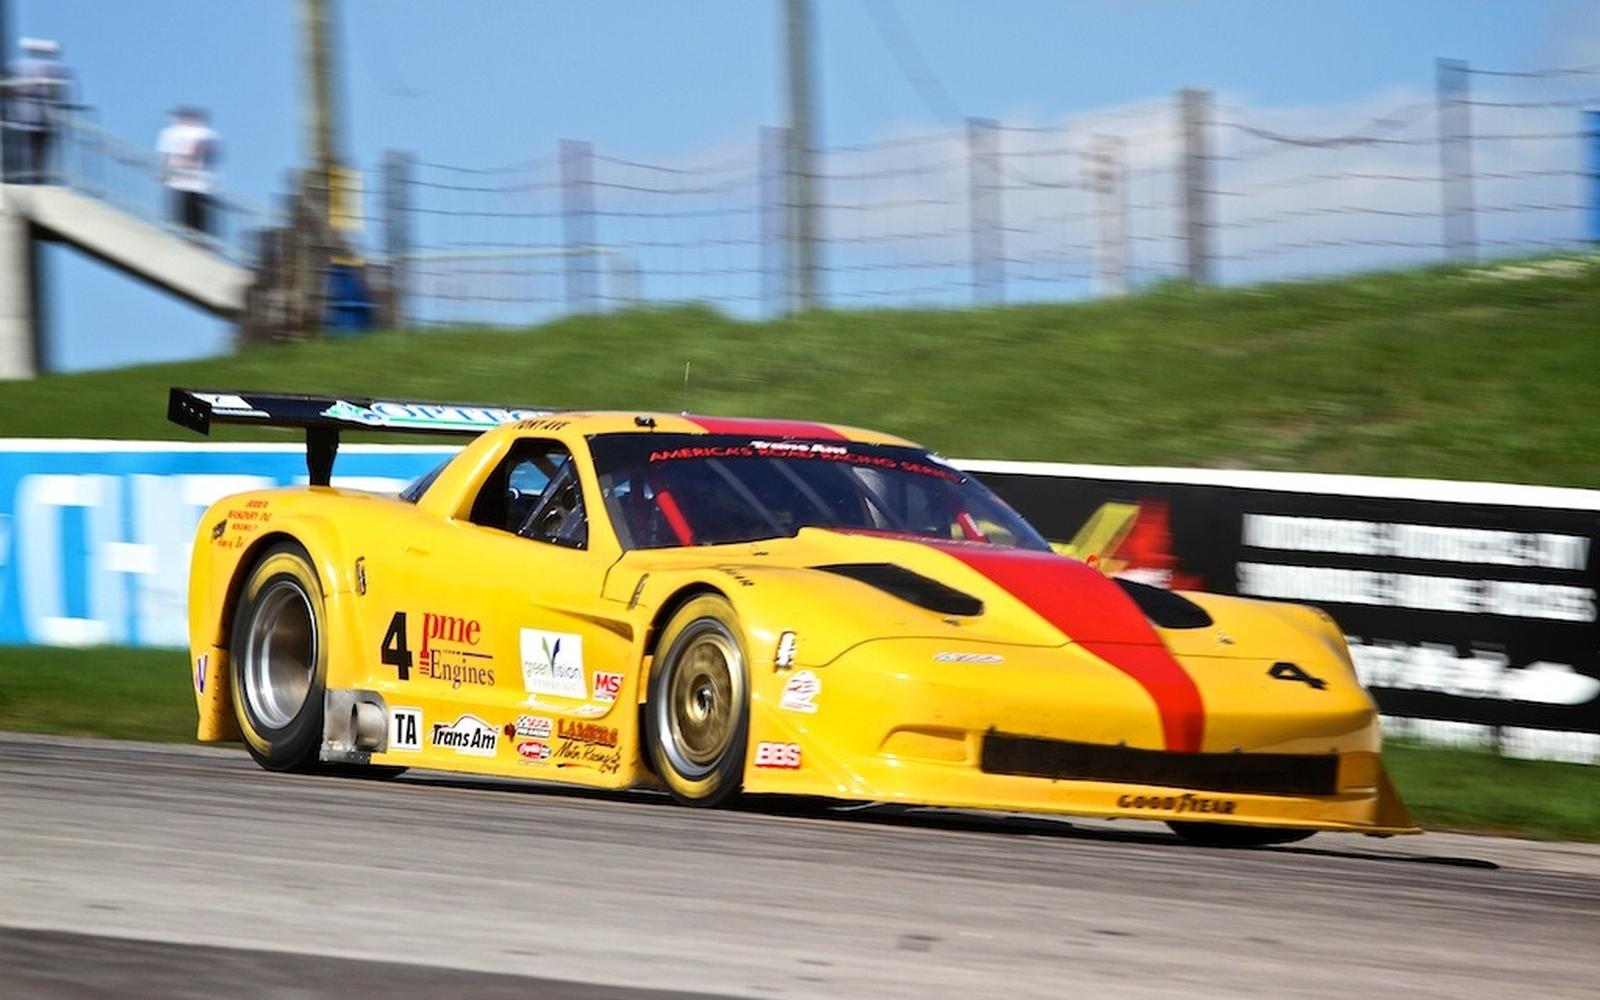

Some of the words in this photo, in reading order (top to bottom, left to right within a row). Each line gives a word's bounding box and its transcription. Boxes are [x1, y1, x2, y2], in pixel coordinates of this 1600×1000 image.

[381, 611, 413, 681] 4
[420, 612, 481, 662] pme
[430, 648, 496, 690] Engines
[1267, 661, 1330, 690] 4
[395, 713, 417, 745] TA
[432, 724, 469, 746] Trans
[469, 727, 496, 750] Am
[754, 740, 800, 769] BBS
[1116, 793, 1237, 815] GOODYEAR
